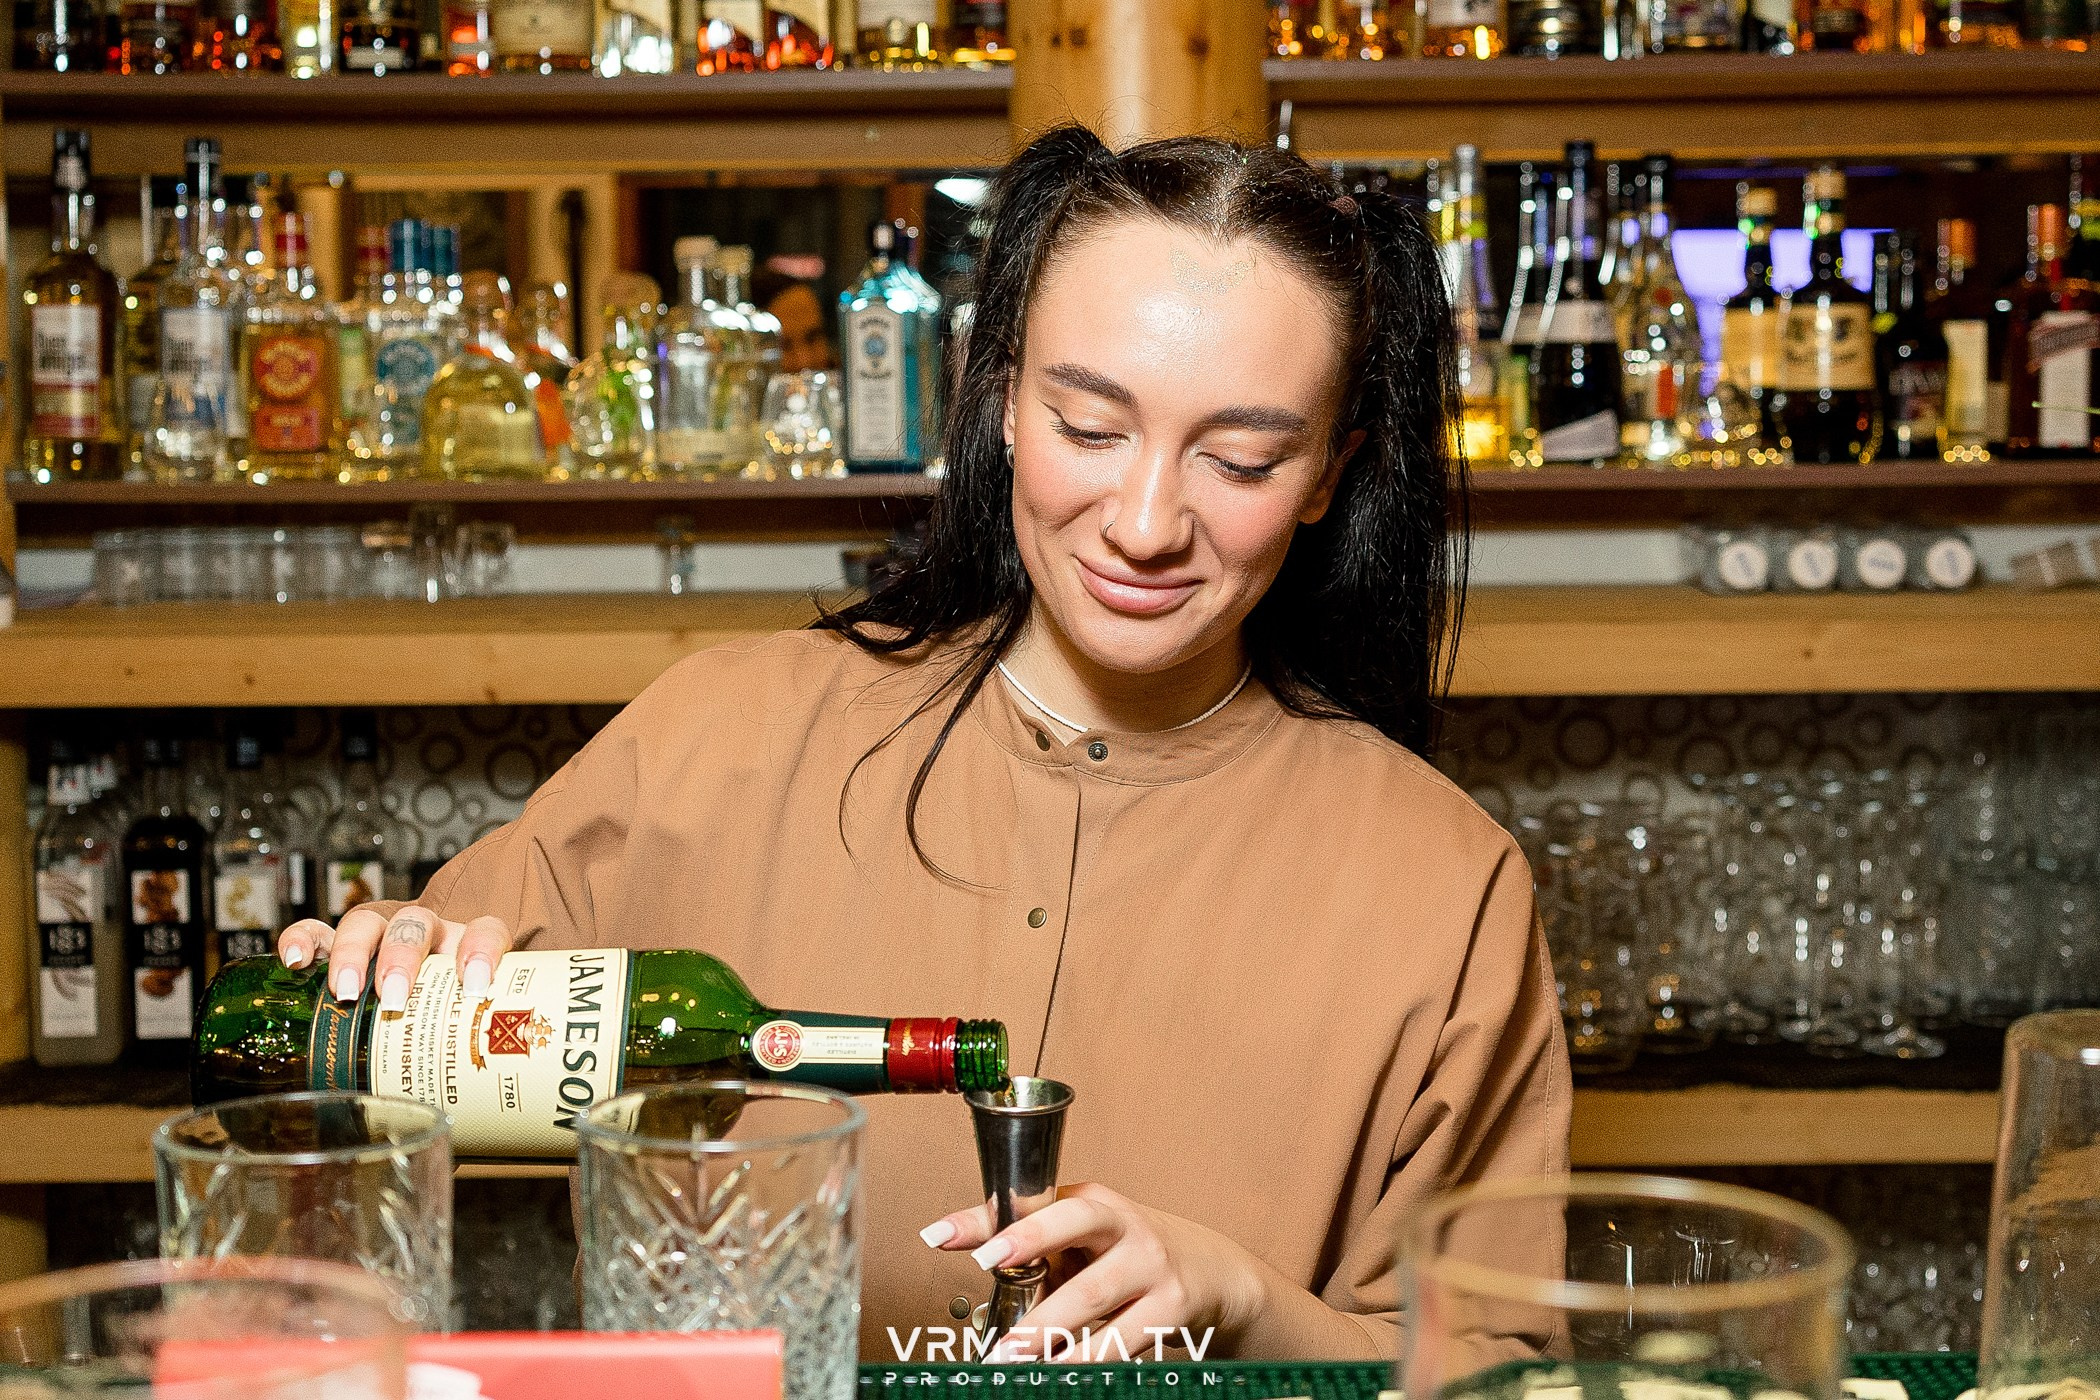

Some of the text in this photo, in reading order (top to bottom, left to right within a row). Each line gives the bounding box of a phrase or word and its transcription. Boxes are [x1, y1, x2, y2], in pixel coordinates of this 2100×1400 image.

[430, 972, 441, 989] JOHN
[438, 968, 453, 994] SMOOTH
[420, 991, 434, 1030] JAMESON
[432, 997, 441, 1020] IRISH
[383, 1031, 389, 1039] OF
[401, 982, 425, 1097] IRISH WHISKEY
[427, 1023, 436, 1066] WHISKEY
[446, 980, 463, 1105] IPLE DISTILLED
[552, 955, 605, 1131] JAMESON
[503, 1076, 516, 1109] 1780
